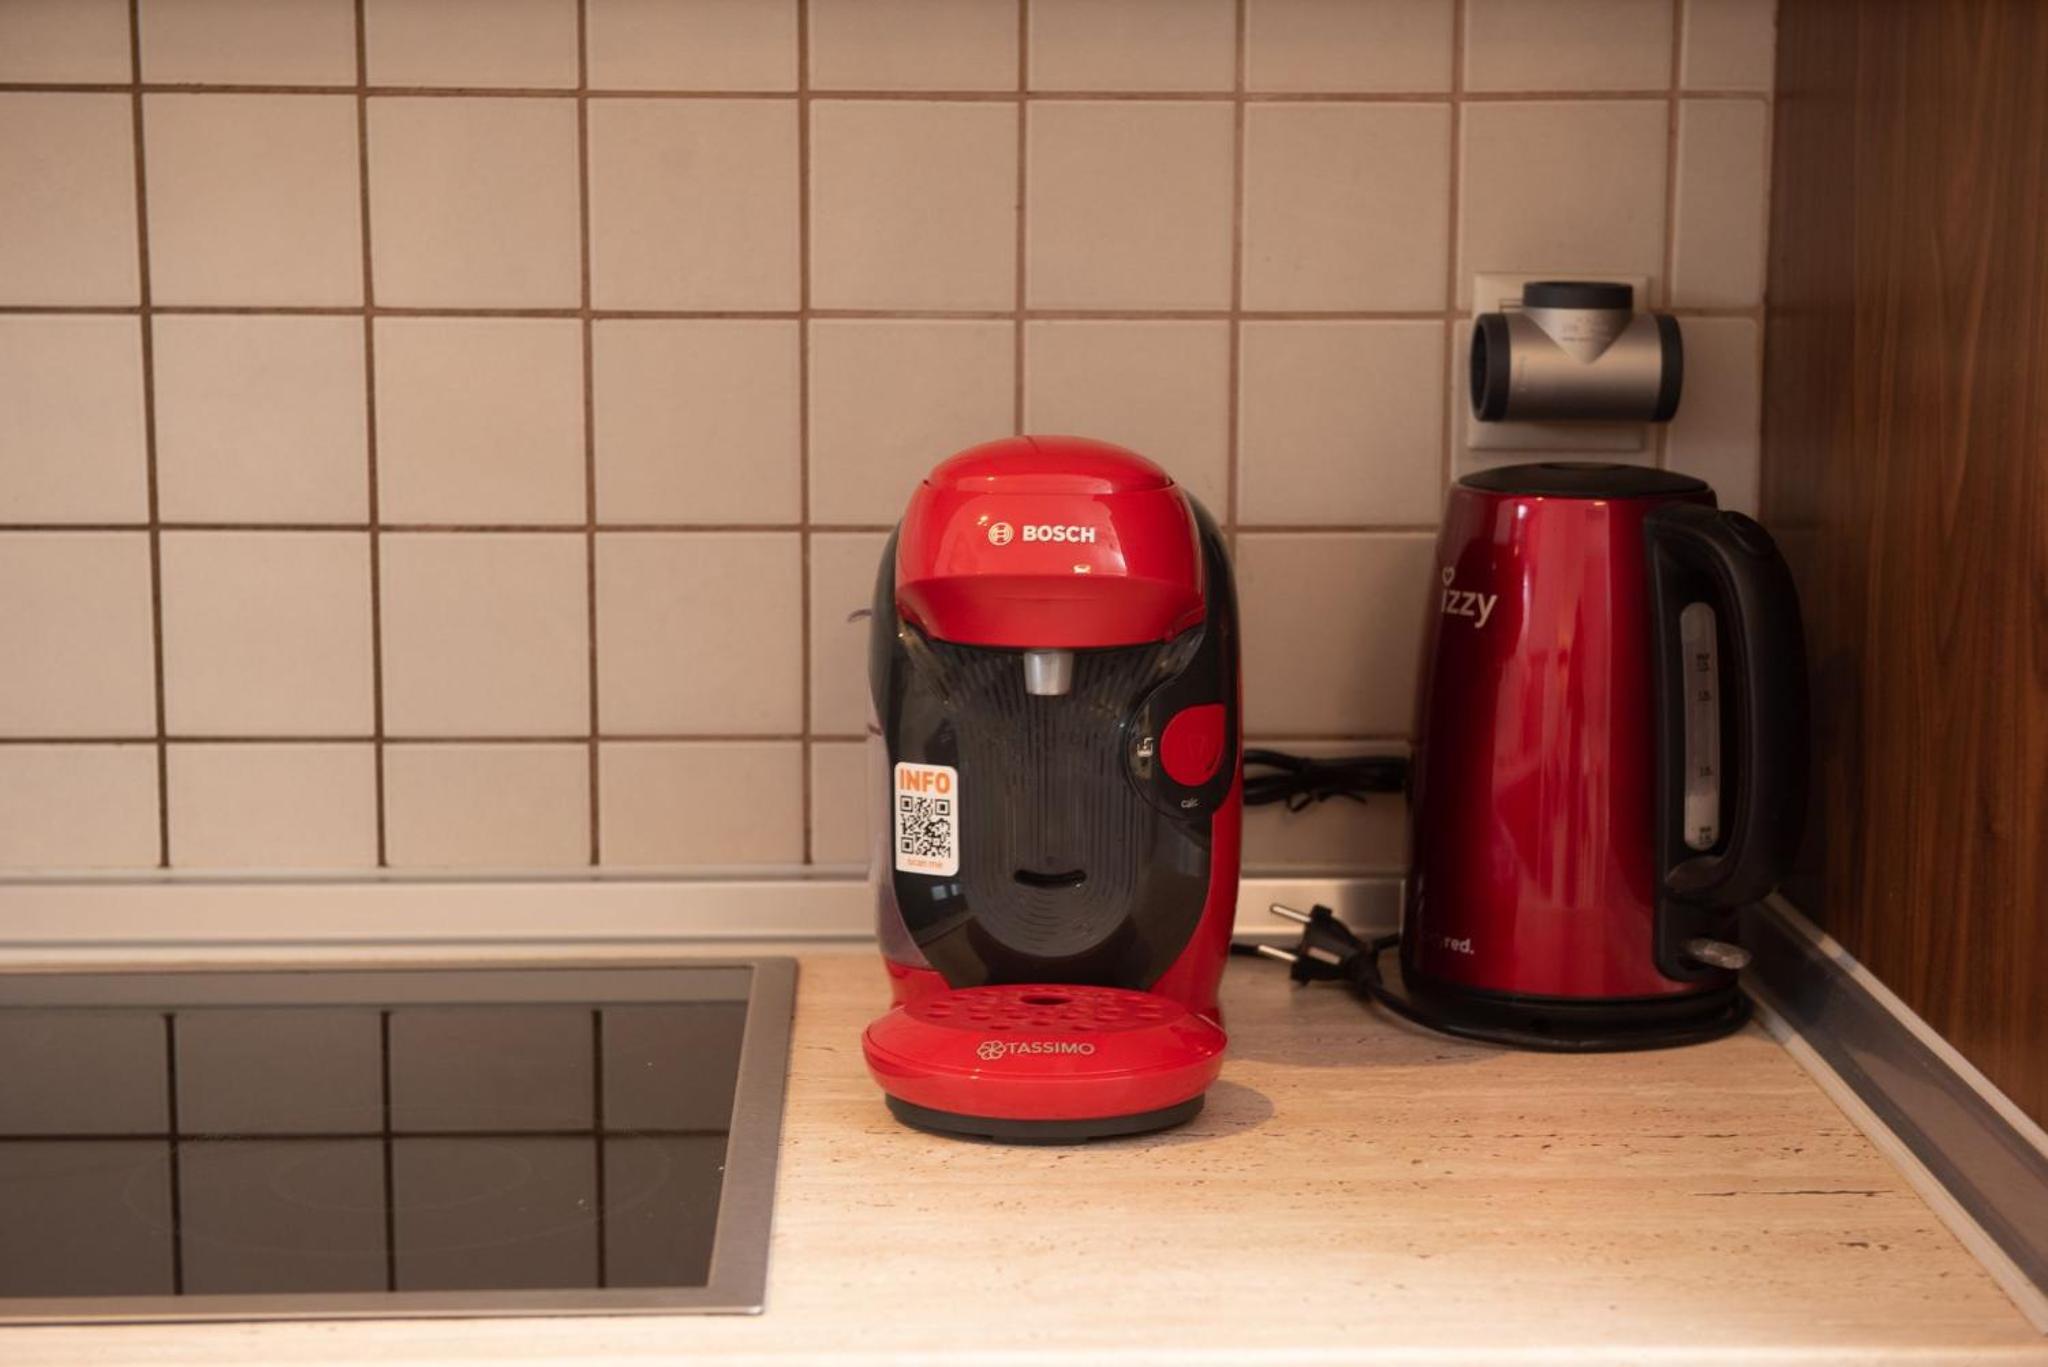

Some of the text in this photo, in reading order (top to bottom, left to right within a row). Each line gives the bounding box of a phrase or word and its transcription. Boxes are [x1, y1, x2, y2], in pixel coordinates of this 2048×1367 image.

[1022, 525, 1096, 543] BOSCH
[1441, 567, 1498, 628] izzy
[900, 769, 951, 795] INFO
[1005, 1041, 1095, 1055] TASSIMO
